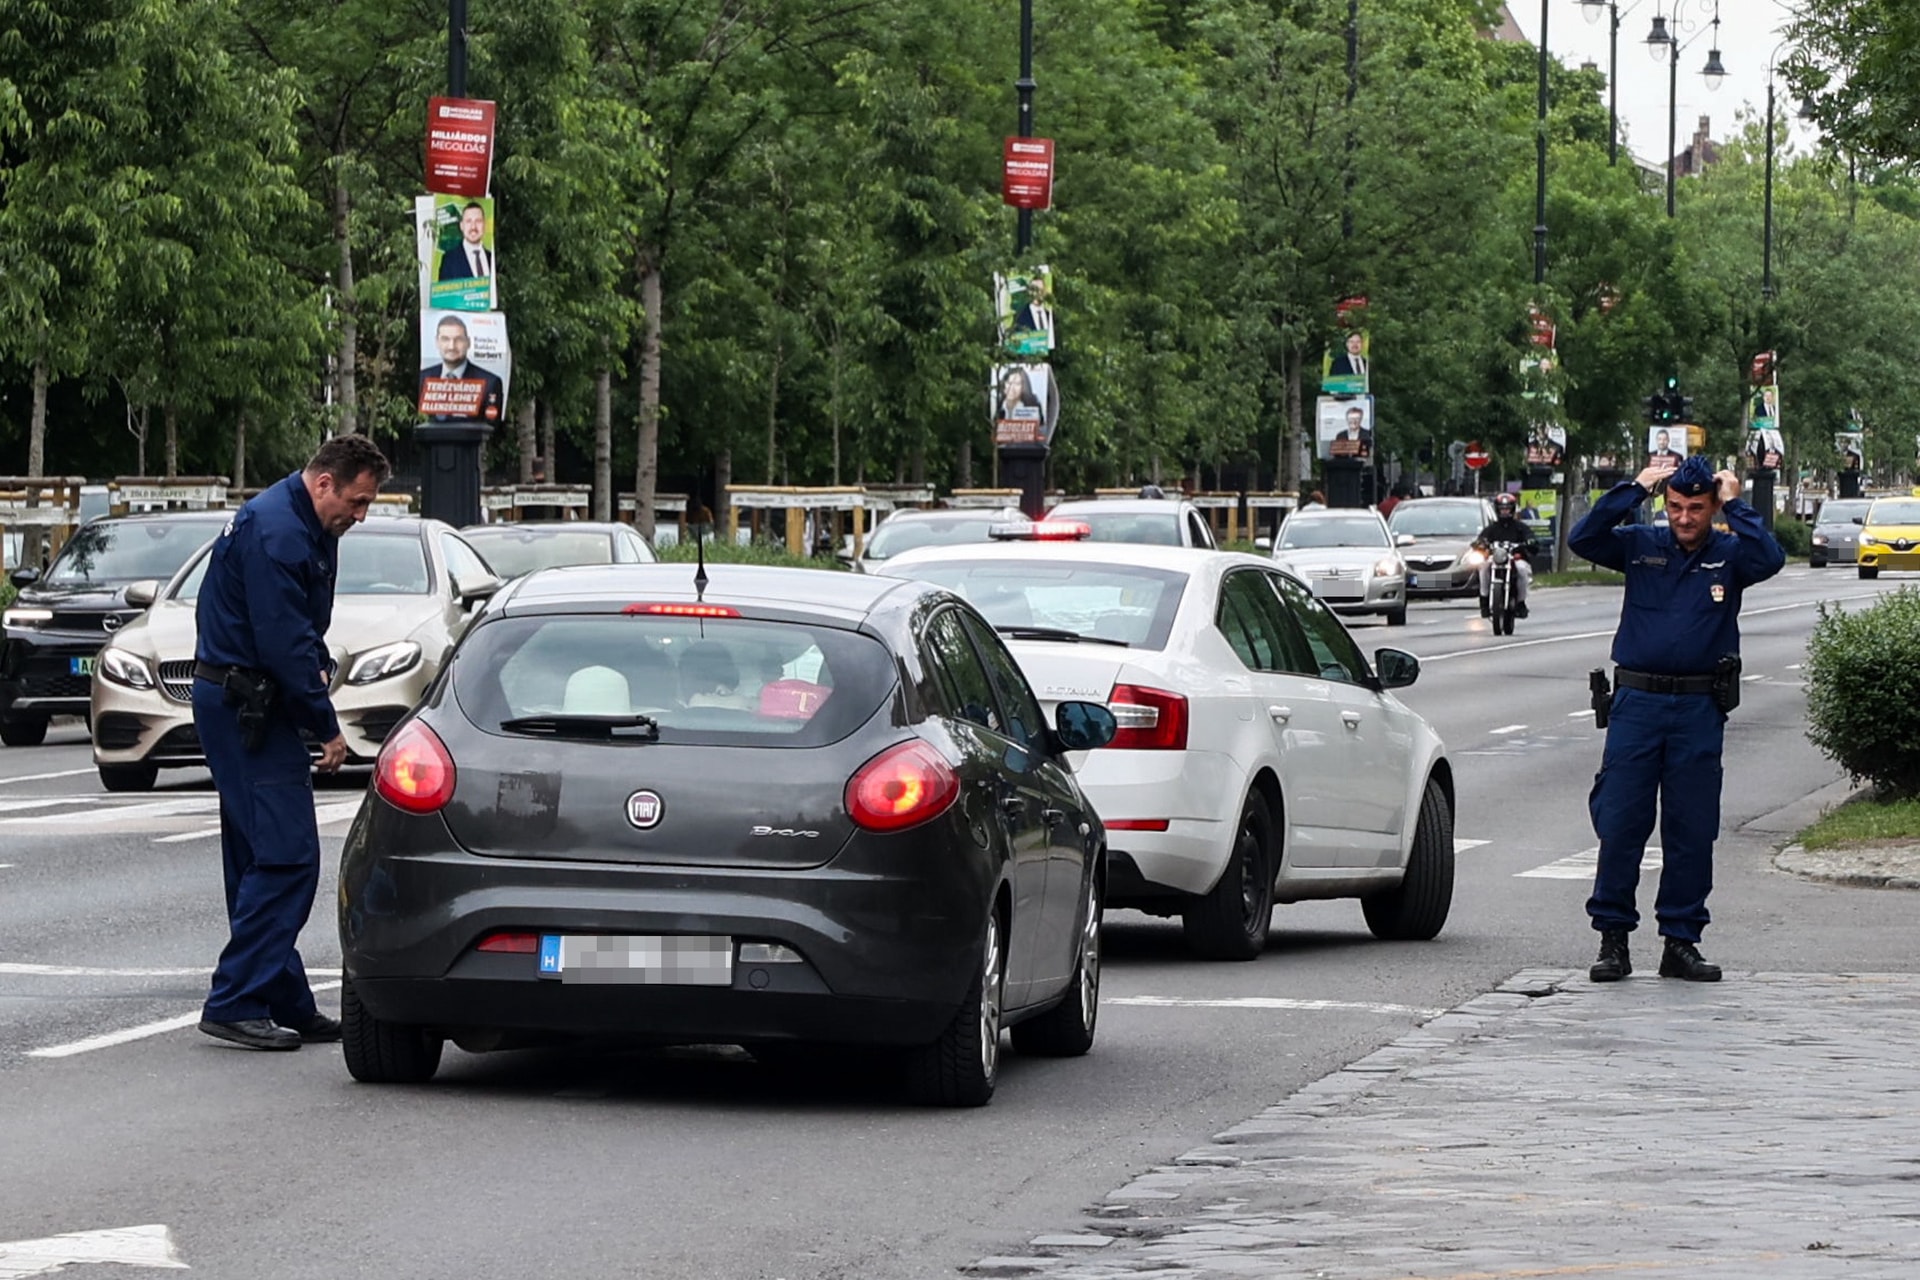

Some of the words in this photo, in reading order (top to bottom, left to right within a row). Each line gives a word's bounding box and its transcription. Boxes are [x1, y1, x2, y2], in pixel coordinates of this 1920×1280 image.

[431, 130, 487, 143] MILLIÁRDOS
[431, 140, 486, 154] MEGOLDÁS
[427, 380, 482, 393] TERÉZVÁROS
[424, 392, 447, 402] NEM
[448, 393, 480, 403] LEHET
[635, 802, 655, 818] FIAT
[750, 826, 819, 838] Bravo
[544, 955, 555, 968] H
